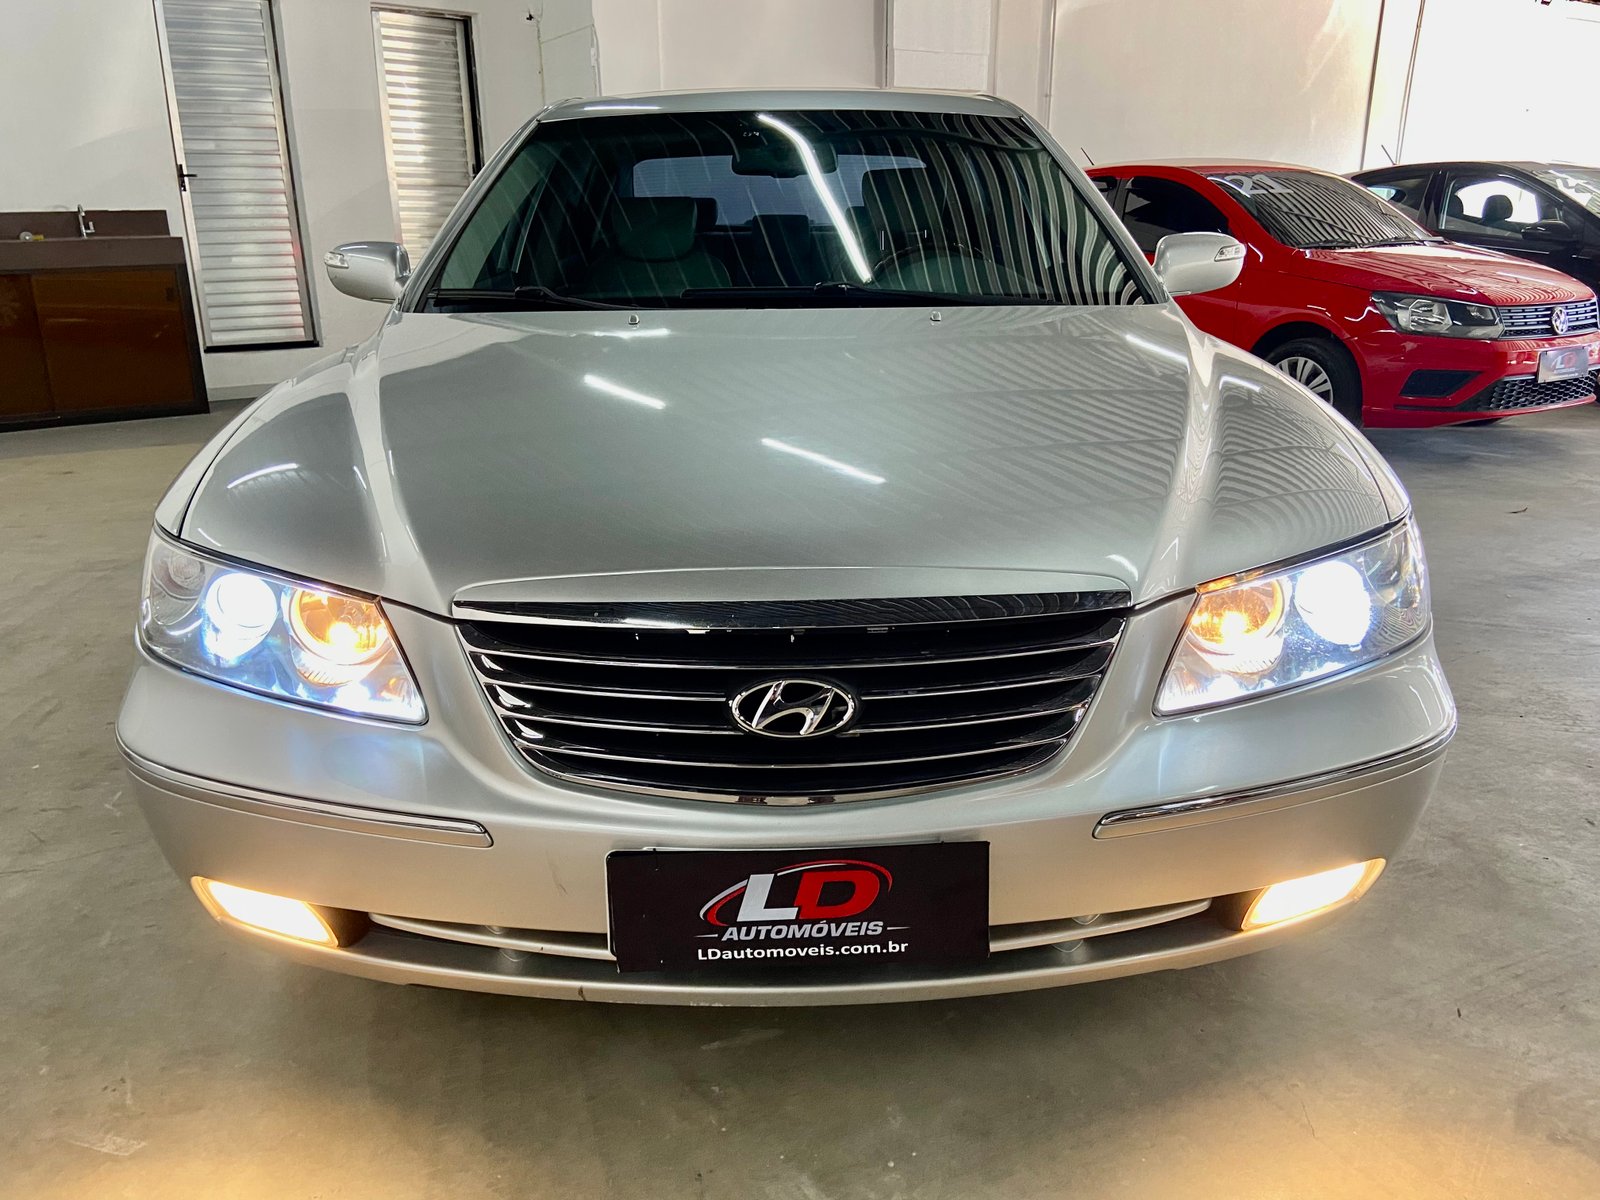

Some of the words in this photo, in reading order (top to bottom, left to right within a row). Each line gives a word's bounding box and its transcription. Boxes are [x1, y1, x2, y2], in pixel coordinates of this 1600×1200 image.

[736, 870, 880, 922] LD
[721, 920, 884, 942] AUTOMÓVEIS
[697, 940, 909, 961] LDautomoveis.com.br
